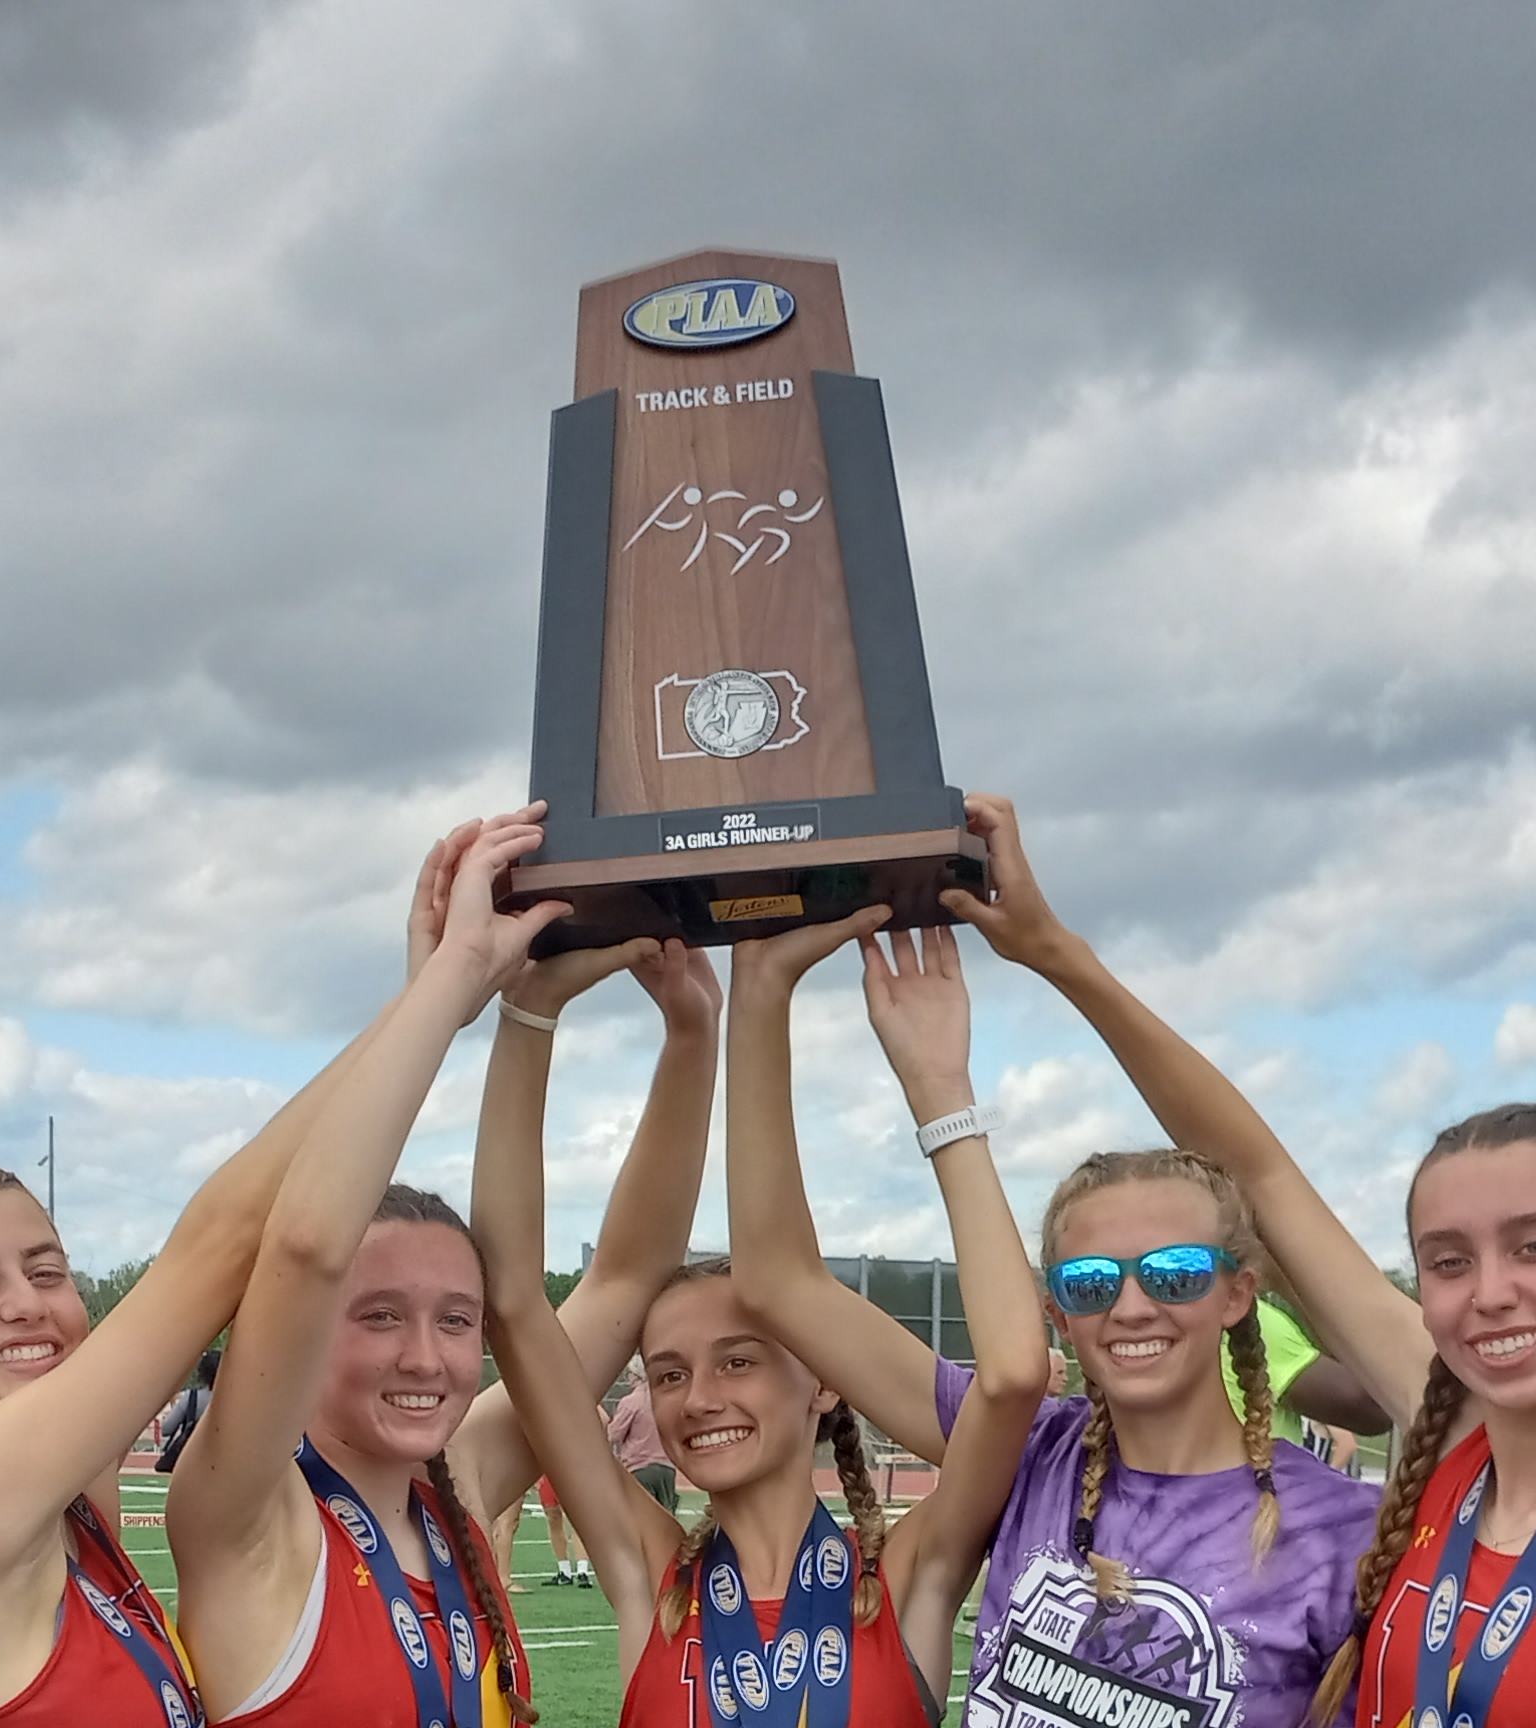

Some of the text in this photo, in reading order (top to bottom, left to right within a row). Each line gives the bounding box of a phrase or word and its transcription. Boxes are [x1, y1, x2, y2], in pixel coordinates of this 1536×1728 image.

[650, 284, 782, 338] PIAA
[635, 378, 794, 412] TRACK & FIELD
[665, 824, 814, 850] 3A GIRLS RUNNER-UP
[723, 813, 756, 830] 2022
[336, 1506, 374, 1549] PIAA
[824, 1542, 844, 1583] PIAA
[714, 1566, 736, 1606] PIAA
[1033, 1607, 1077, 1644] STATE
[1431, 1587, 1455, 1645] PIAA
[1487, 1593, 1528, 1651] PIAA
[737, 1655, 764, 1702] PIAA
[777, 1637, 804, 1683] PIAA
[820, 1636, 840, 1680] PIAA
